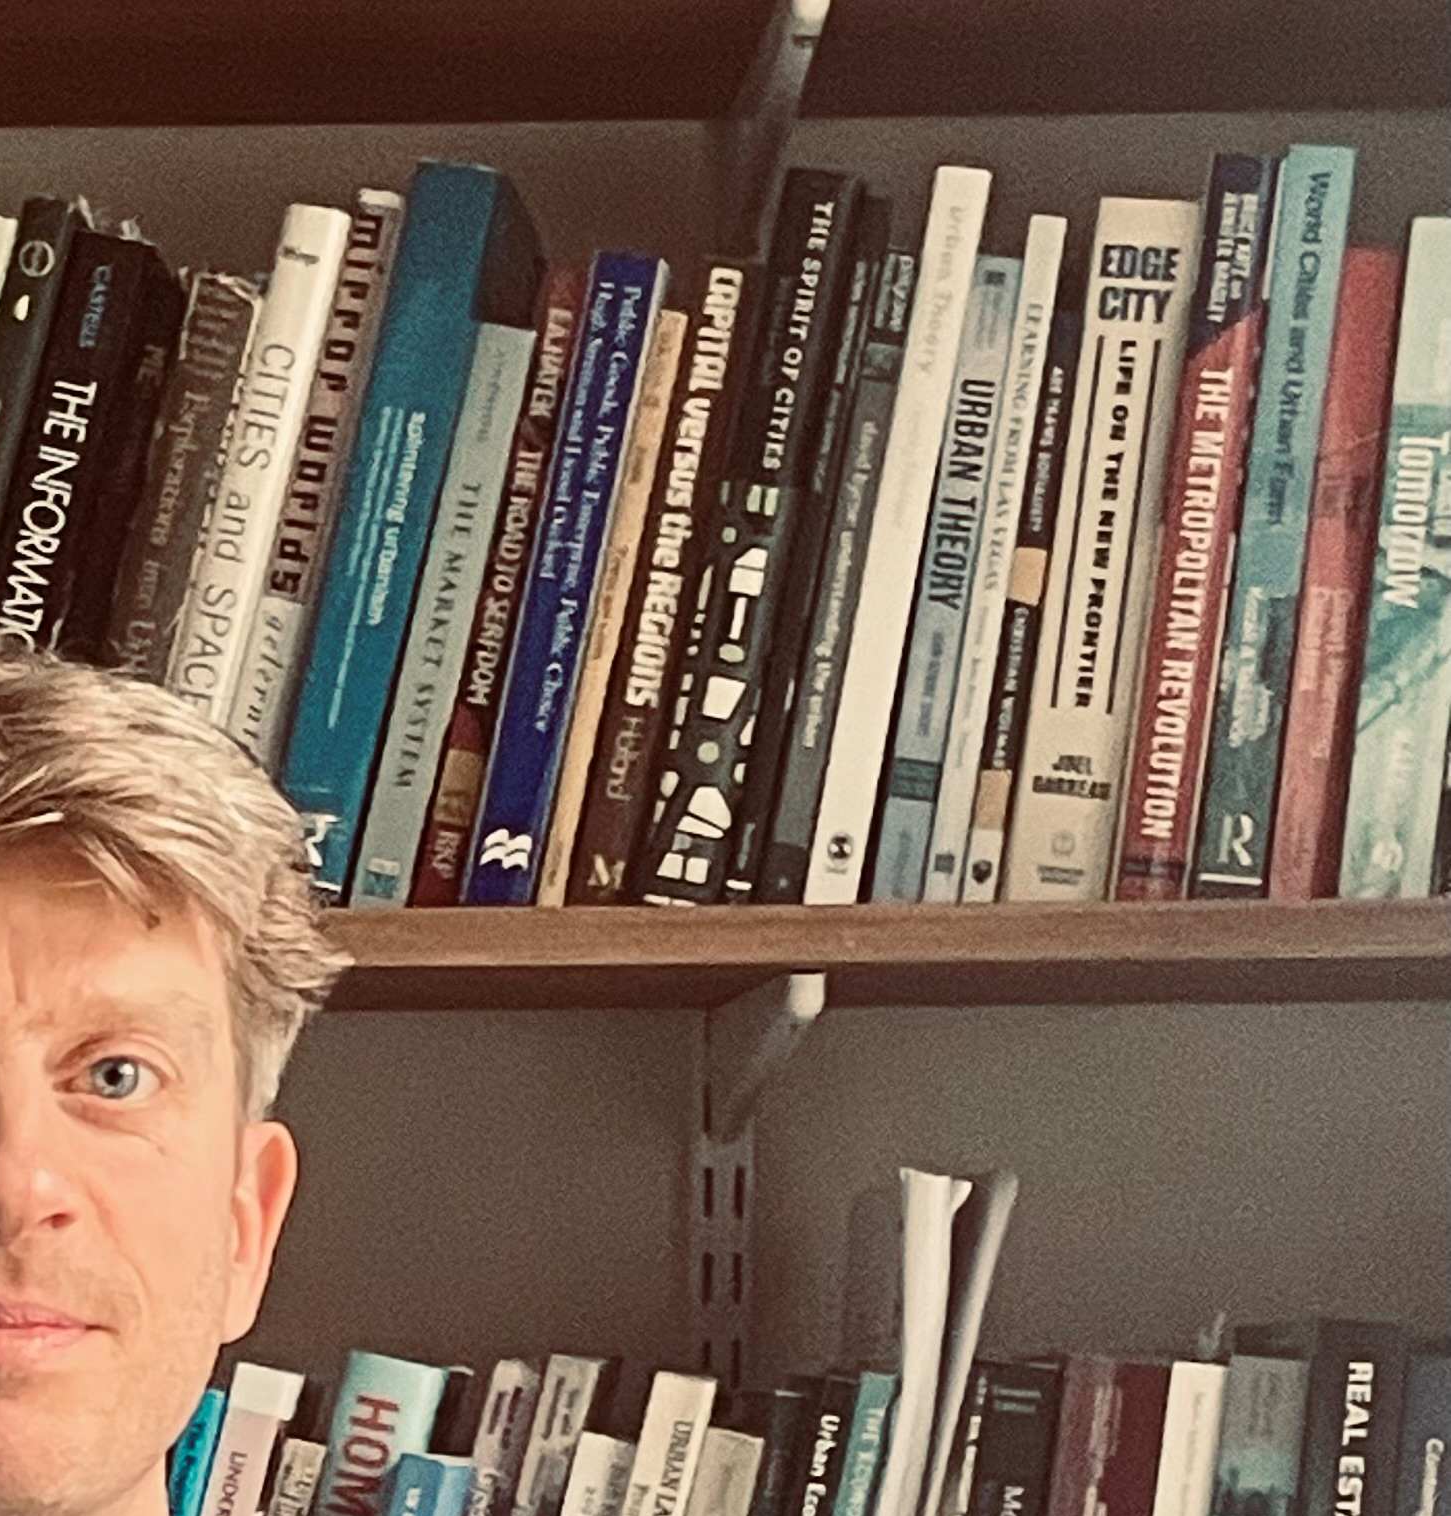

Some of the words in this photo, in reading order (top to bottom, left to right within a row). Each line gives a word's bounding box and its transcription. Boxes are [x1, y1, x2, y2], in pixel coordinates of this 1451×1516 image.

[807, 202, 834, 251] THE
[1300, 171, 1330, 245] World
[935, 205, 964, 283] Urban
[1099, 243, 1180, 281] EDGE
[315, 209, 385, 393] mirror
[614, 286, 642, 343] Public
[789, 257, 822, 341] SPIRIT
[1097, 286, 1173, 323] CITY
[1291, 250, 1321, 321] Cities
[688, 267, 743, 392] CAPITAL
[781, 347, 803, 381] OF
[914, 291, 954, 374] Theory
[1012, 303, 1044, 409] LEARNING
[1284, 327, 1306, 373] and
[1115, 340, 1137, 395] LIFE
[1195, 366, 1234, 423] THE
[43, 380, 97, 442] THE
[234, 343, 295, 470] CITIES
[762, 387, 795, 469] CITIES
[947, 378, 996, 482] URBAN
[1109, 404, 1129, 440] ON
[385, 411, 426, 524] splintering
[512, 450, 543, 490] THE
[585, 424, 614, 483] Public
[665, 397, 711, 508] versus
[1001, 416, 1023, 474] FROM
[1101, 451, 1124, 501] THE
[212, 490, 251, 563] and
[269, 414, 339, 595] worlds
[451, 483, 482, 535] THE
[498, 495, 532, 561] ROAD
[995, 480, 1013, 518] LAS
[652, 512, 692, 568] the
[927, 496, 977, 611] THEORY
[983, 526, 1008, 591] VEGAS
[1092, 510, 1116, 569] NEW
[1165, 430, 1228, 652] METROPOLITAN
[422, 550, 464, 668] MARKET
[493, 563, 517, 593] TO
[466, 596, 510, 705] SERFDOM
[550, 597, 578, 656] Public
[625, 571, 682, 708] REGIONS
[1075, 577, 1106, 708] FRONTIER
[535, 662, 563, 732] Choice
[394, 683, 435, 787] SYSTEM
[606, 716, 643, 801] Holland
[1141, 659, 1197, 838] REVOLUTION
[1217, 814, 1253, 867] R
[860, 1407, 886, 1443] THE
[1341, 1362, 1374, 1446] REAL
[660, 1420, 693, 1491] URBAN
[810, 1414, 841, 1477] Urban
